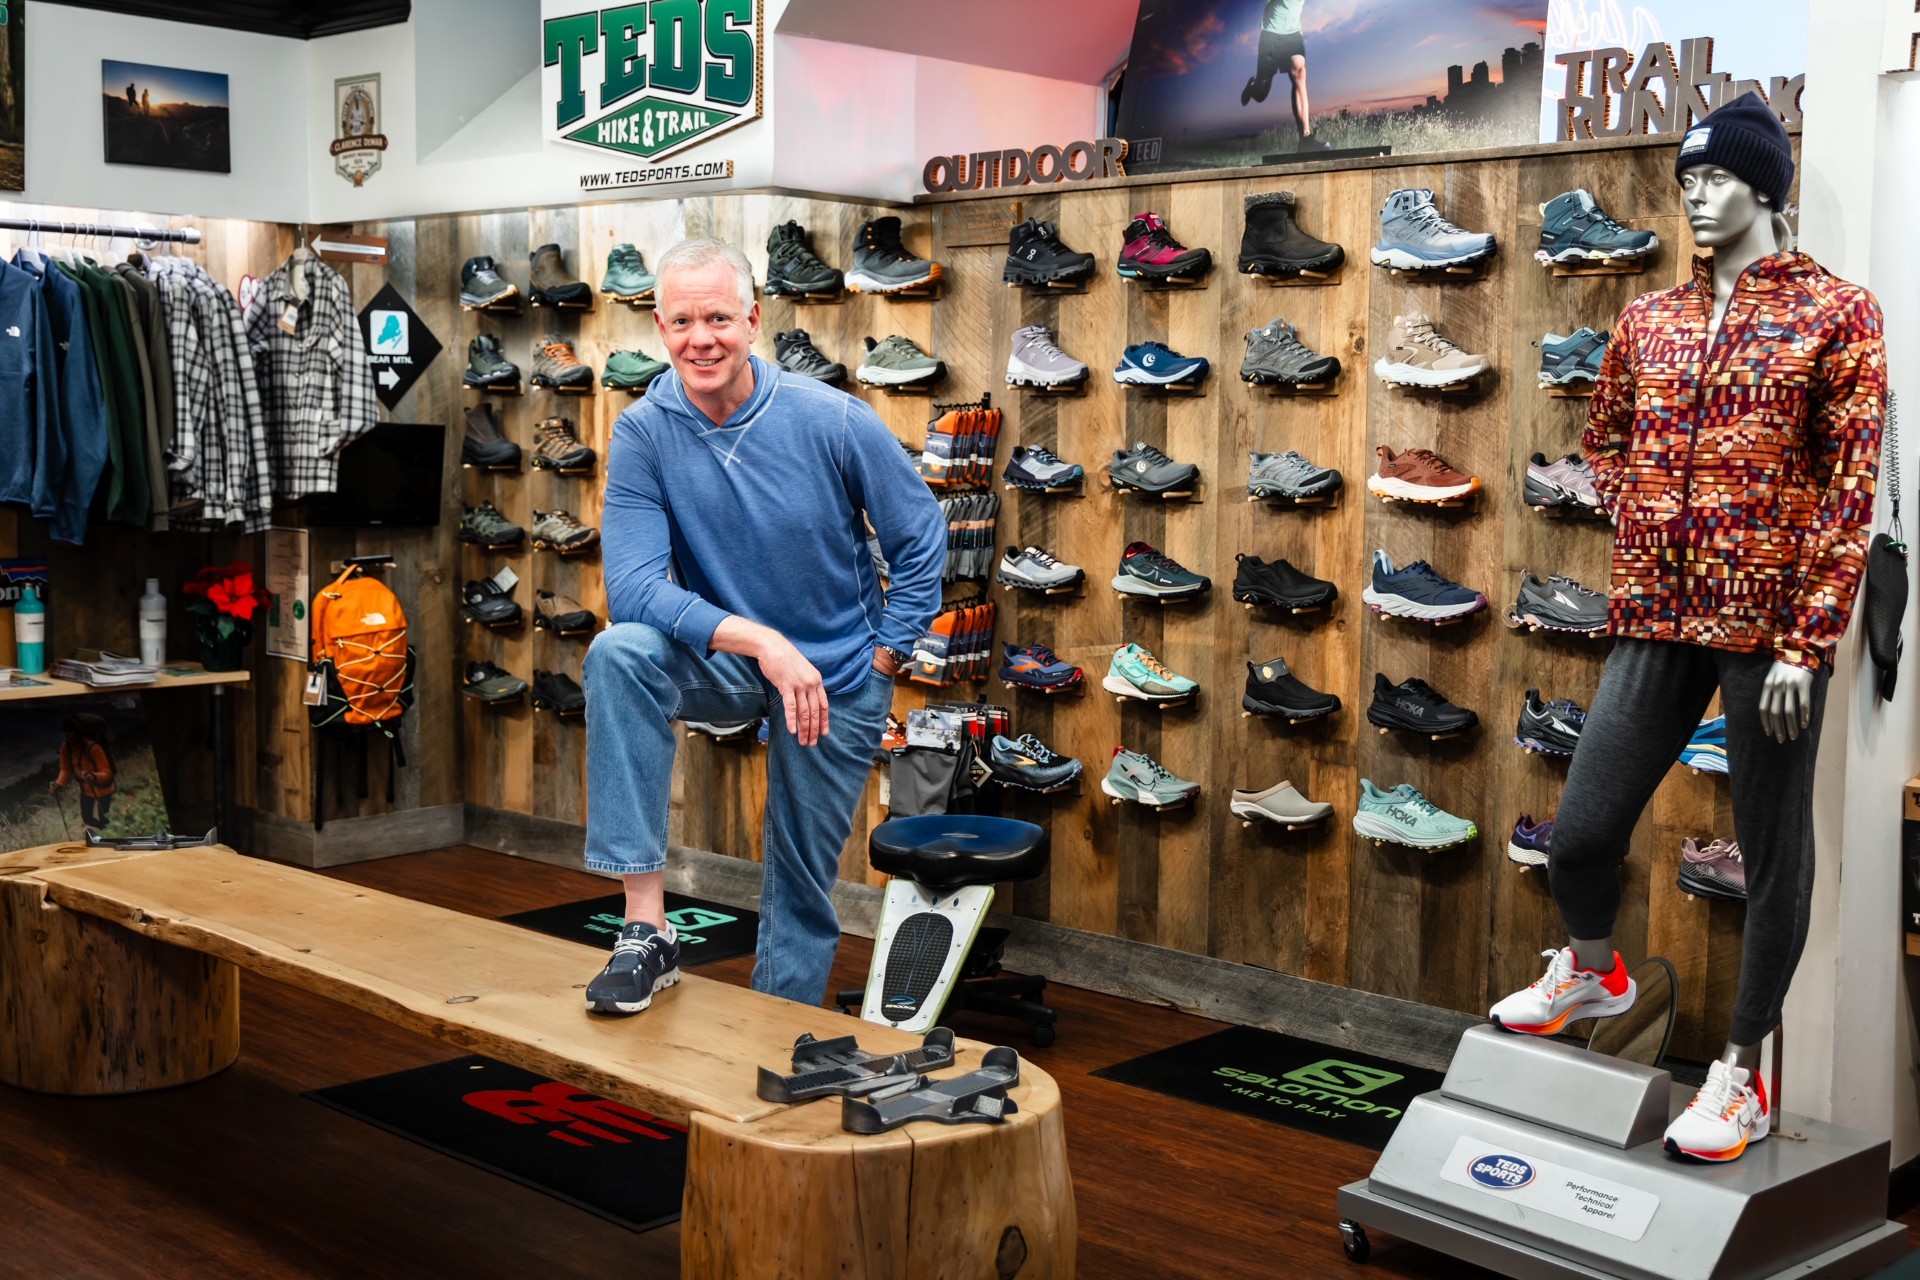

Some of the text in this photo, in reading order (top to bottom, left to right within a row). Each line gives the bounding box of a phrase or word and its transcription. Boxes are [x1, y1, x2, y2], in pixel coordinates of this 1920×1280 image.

[543, 0, 755, 130] TEDS
[1554, 36, 1732, 101] TRAIL
[1131, 141, 1159, 161] EED
[579, 161, 724, 188] WWW.TEDSPORTS.COM
[922, 137, 1129, 194] OUTDOOR
[366, 354, 414, 365] BEAR MTN.
[1394, 697, 1425, 718] HOKA
[1385, 804, 1418, 828] HOKA
[1266, 1095, 1293, 1106] TO
[1293, 1103, 1347, 1119] PLAY
[1474, 1162, 1524, 1184] SPORTS
[1496, 1157, 1529, 1177] TEDS
[1565, 1181, 1619, 1203] Performance
[1573, 1192, 1615, 1211] Technical
[1581, 1204, 1616, 1221] Apparel
